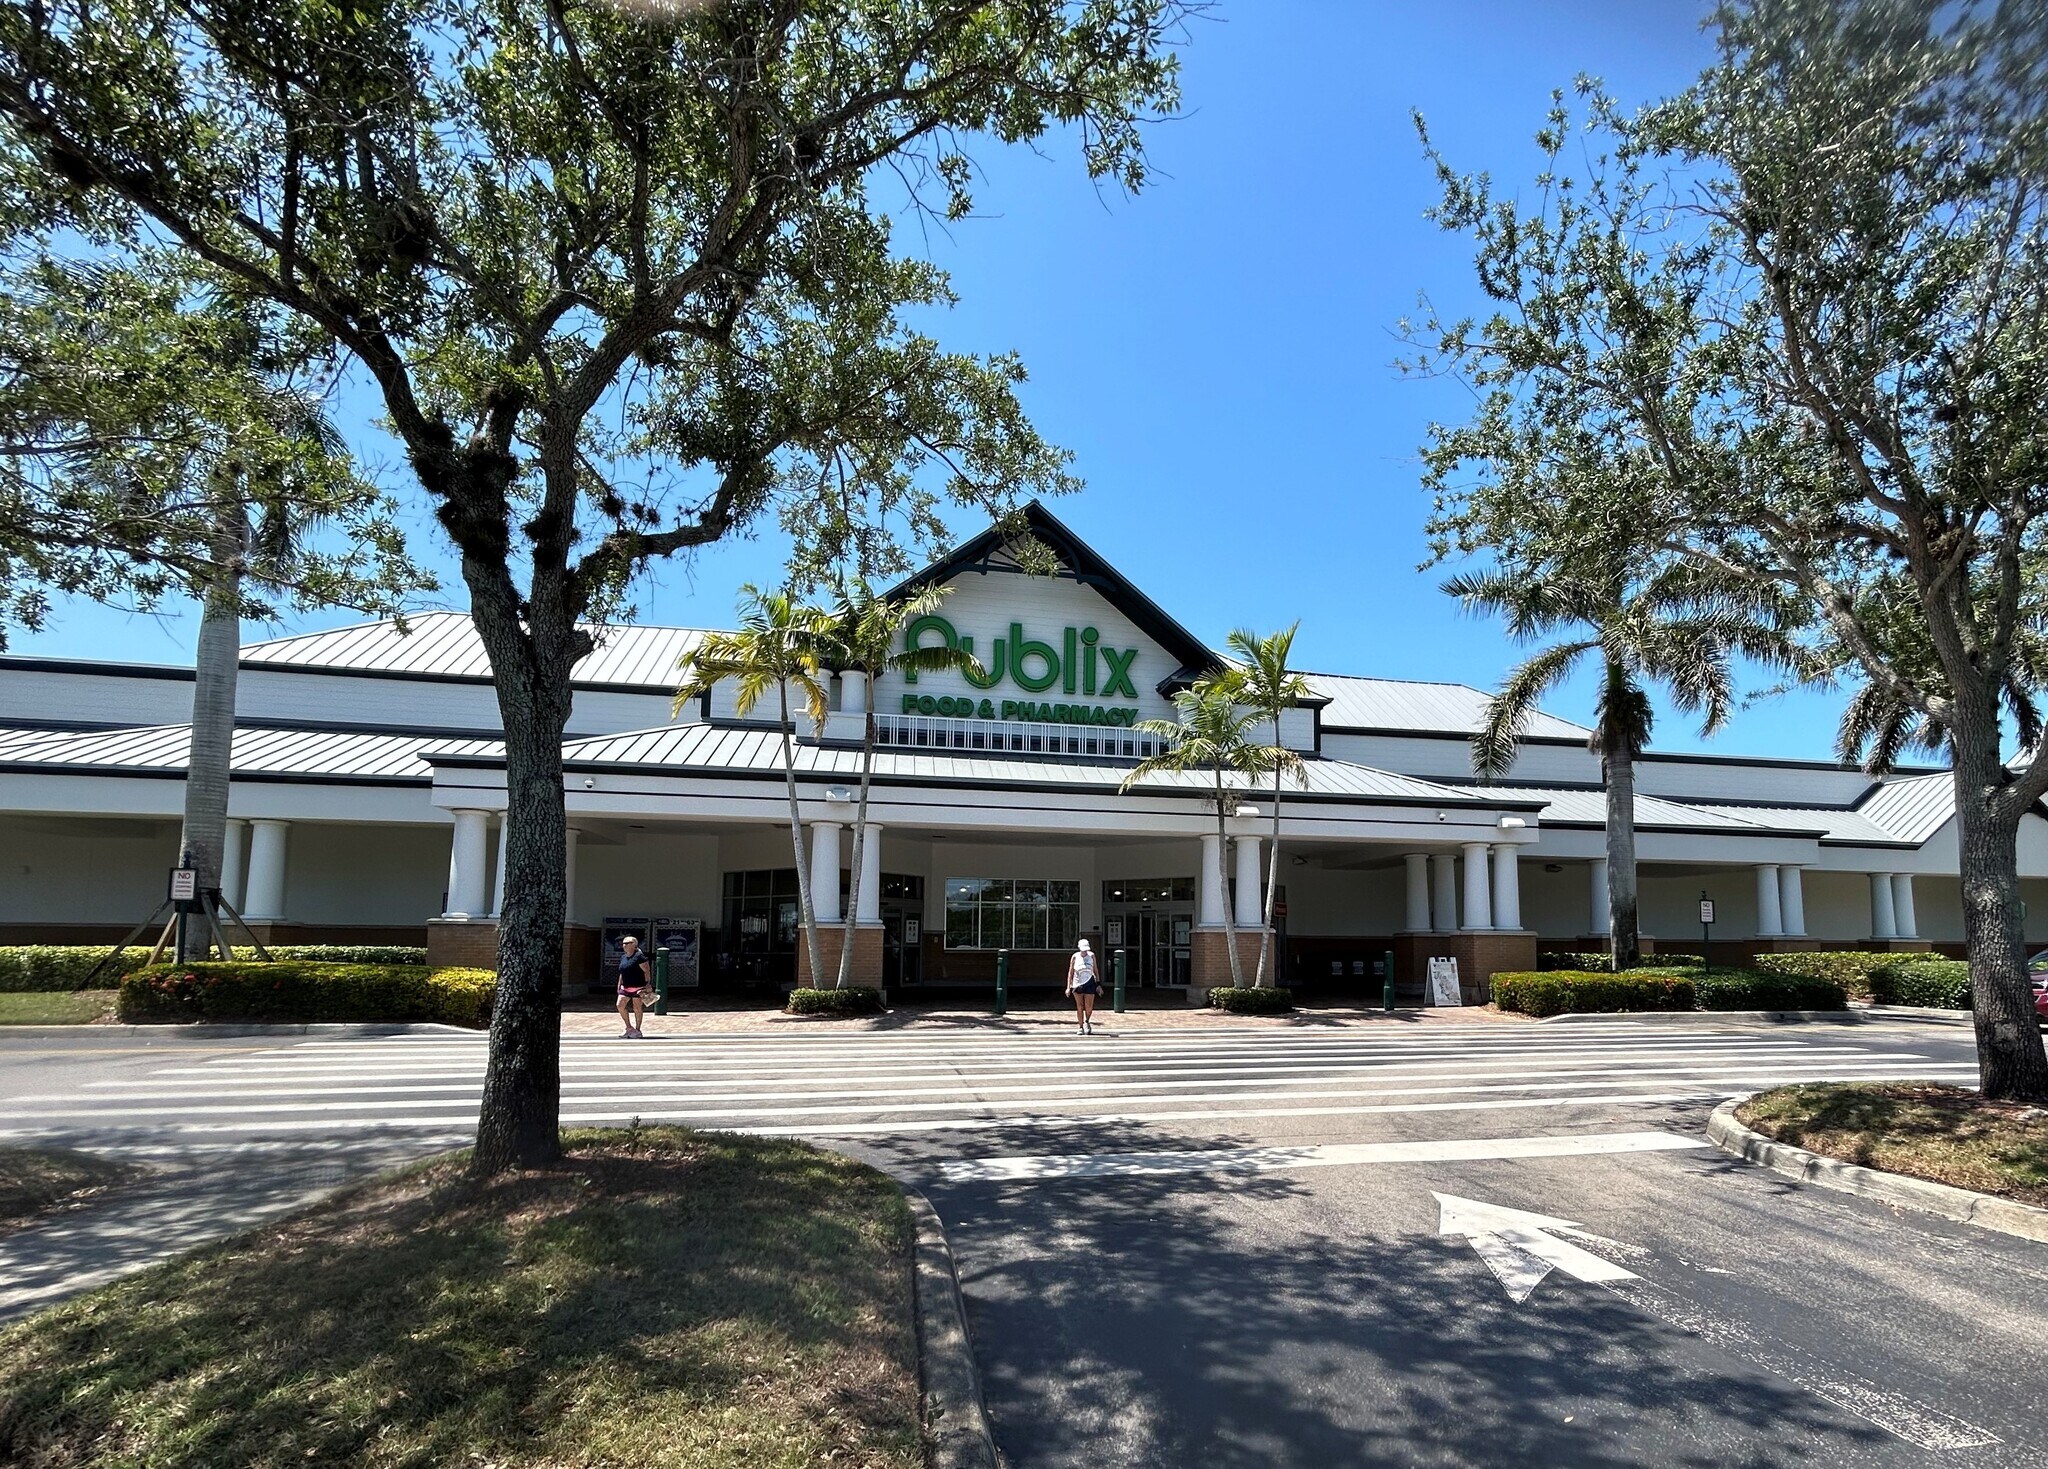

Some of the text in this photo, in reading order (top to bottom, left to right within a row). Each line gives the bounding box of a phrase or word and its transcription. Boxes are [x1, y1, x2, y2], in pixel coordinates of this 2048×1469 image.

[905, 615, 1138, 698] Publix
[903, 694, 1138, 727] FOOD & PHARMACY
